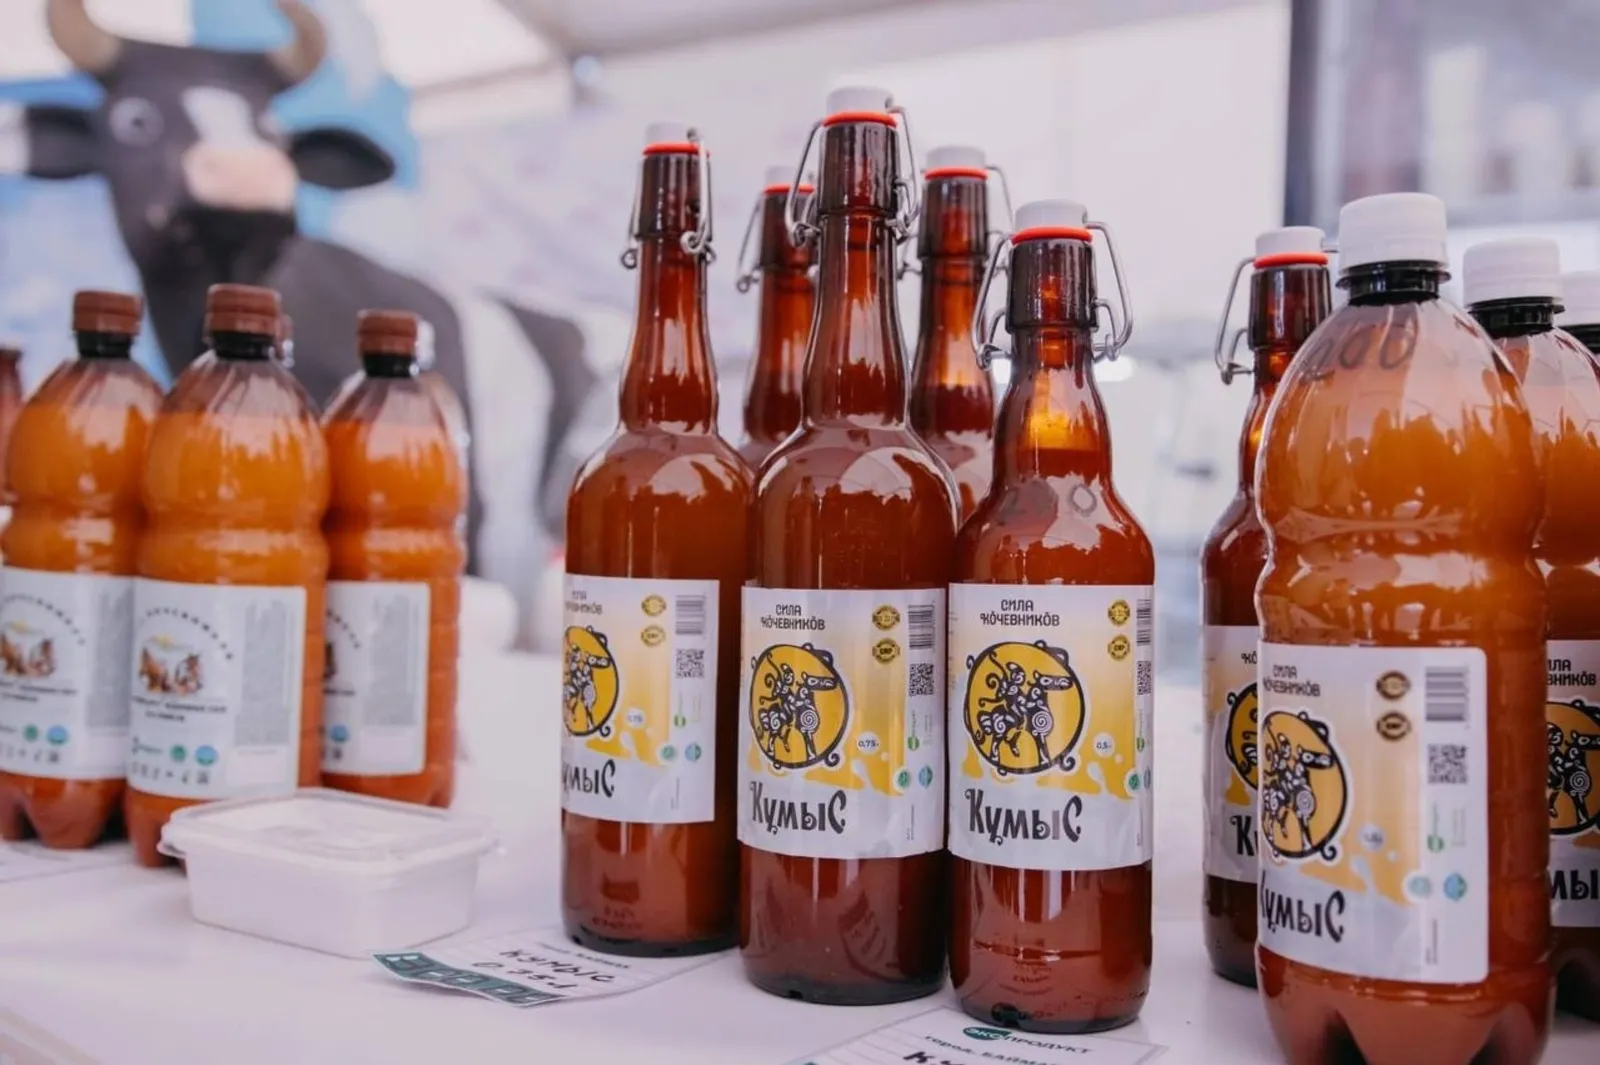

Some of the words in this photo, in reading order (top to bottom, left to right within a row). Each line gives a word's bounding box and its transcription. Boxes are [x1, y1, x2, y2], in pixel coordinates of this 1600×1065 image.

[775, 604, 802, 616] СИЛА
[1000, 600, 1034, 612] СИЛА
[979, 611, 1061, 627] КОЧЕВНИКОВ
